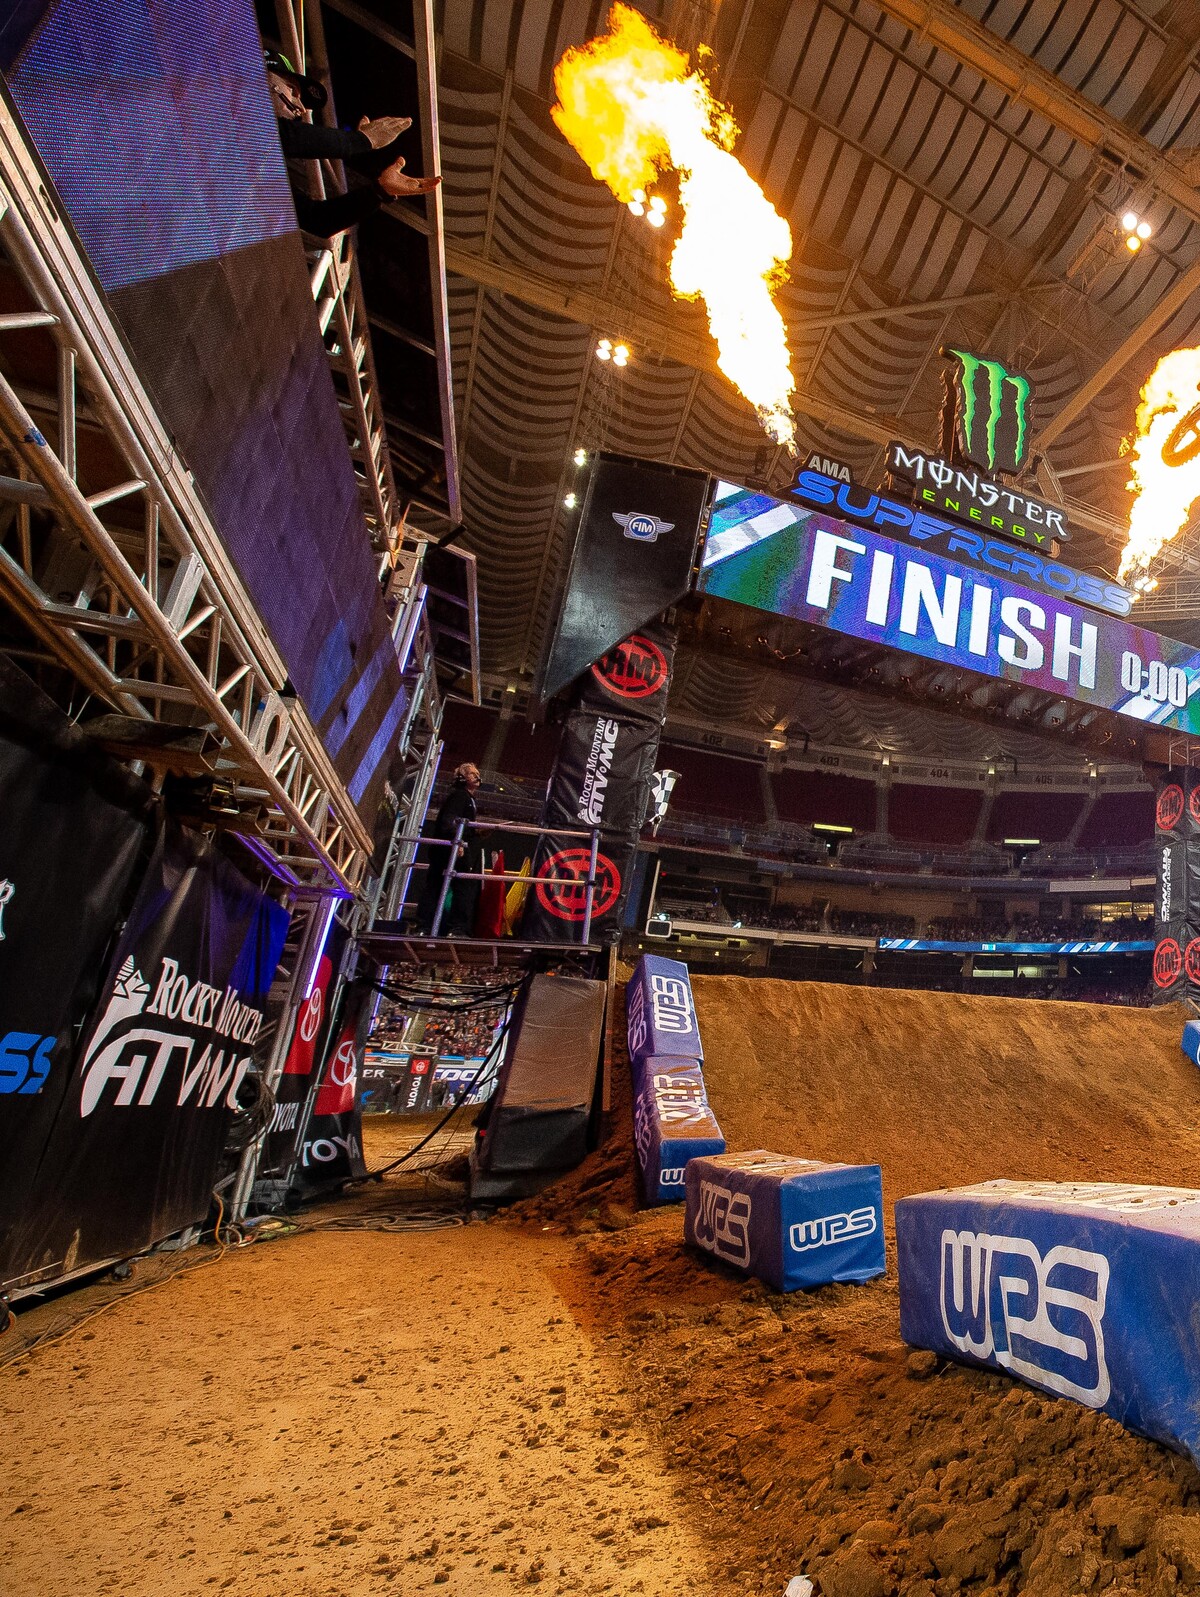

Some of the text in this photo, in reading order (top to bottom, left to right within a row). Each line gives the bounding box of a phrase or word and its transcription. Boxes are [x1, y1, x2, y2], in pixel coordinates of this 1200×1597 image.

[808, 456, 851, 483] AMA
[895, 446, 1069, 536] MONSTER
[632, 521, 653, 533] FIM
[791, 470, 1132, 613] SUPERCROSS
[922, 489, 1046, 544] ENERGY
[806, 529, 1098, 690] FINISH
[1121, 650, 1188, 707] 0:00
[579, 717, 606, 807] ROCKY MOUNTAIN
[701, 733, 723, 747] 402
[820, 755, 840, 767] 403
[930, 768, 949, 779] 404
[1035, 774, 1053, 784] 405
[146, 957, 222, 1029] ROCKY
[652, 975, 693, 1033] WPS
[406, 1076, 422, 1107] TOYOTA
[695, 1178, 751, 1269] WPS
[789, 1206, 877, 1252] WPS
[940, 1229, 1110, 1409] WPS
